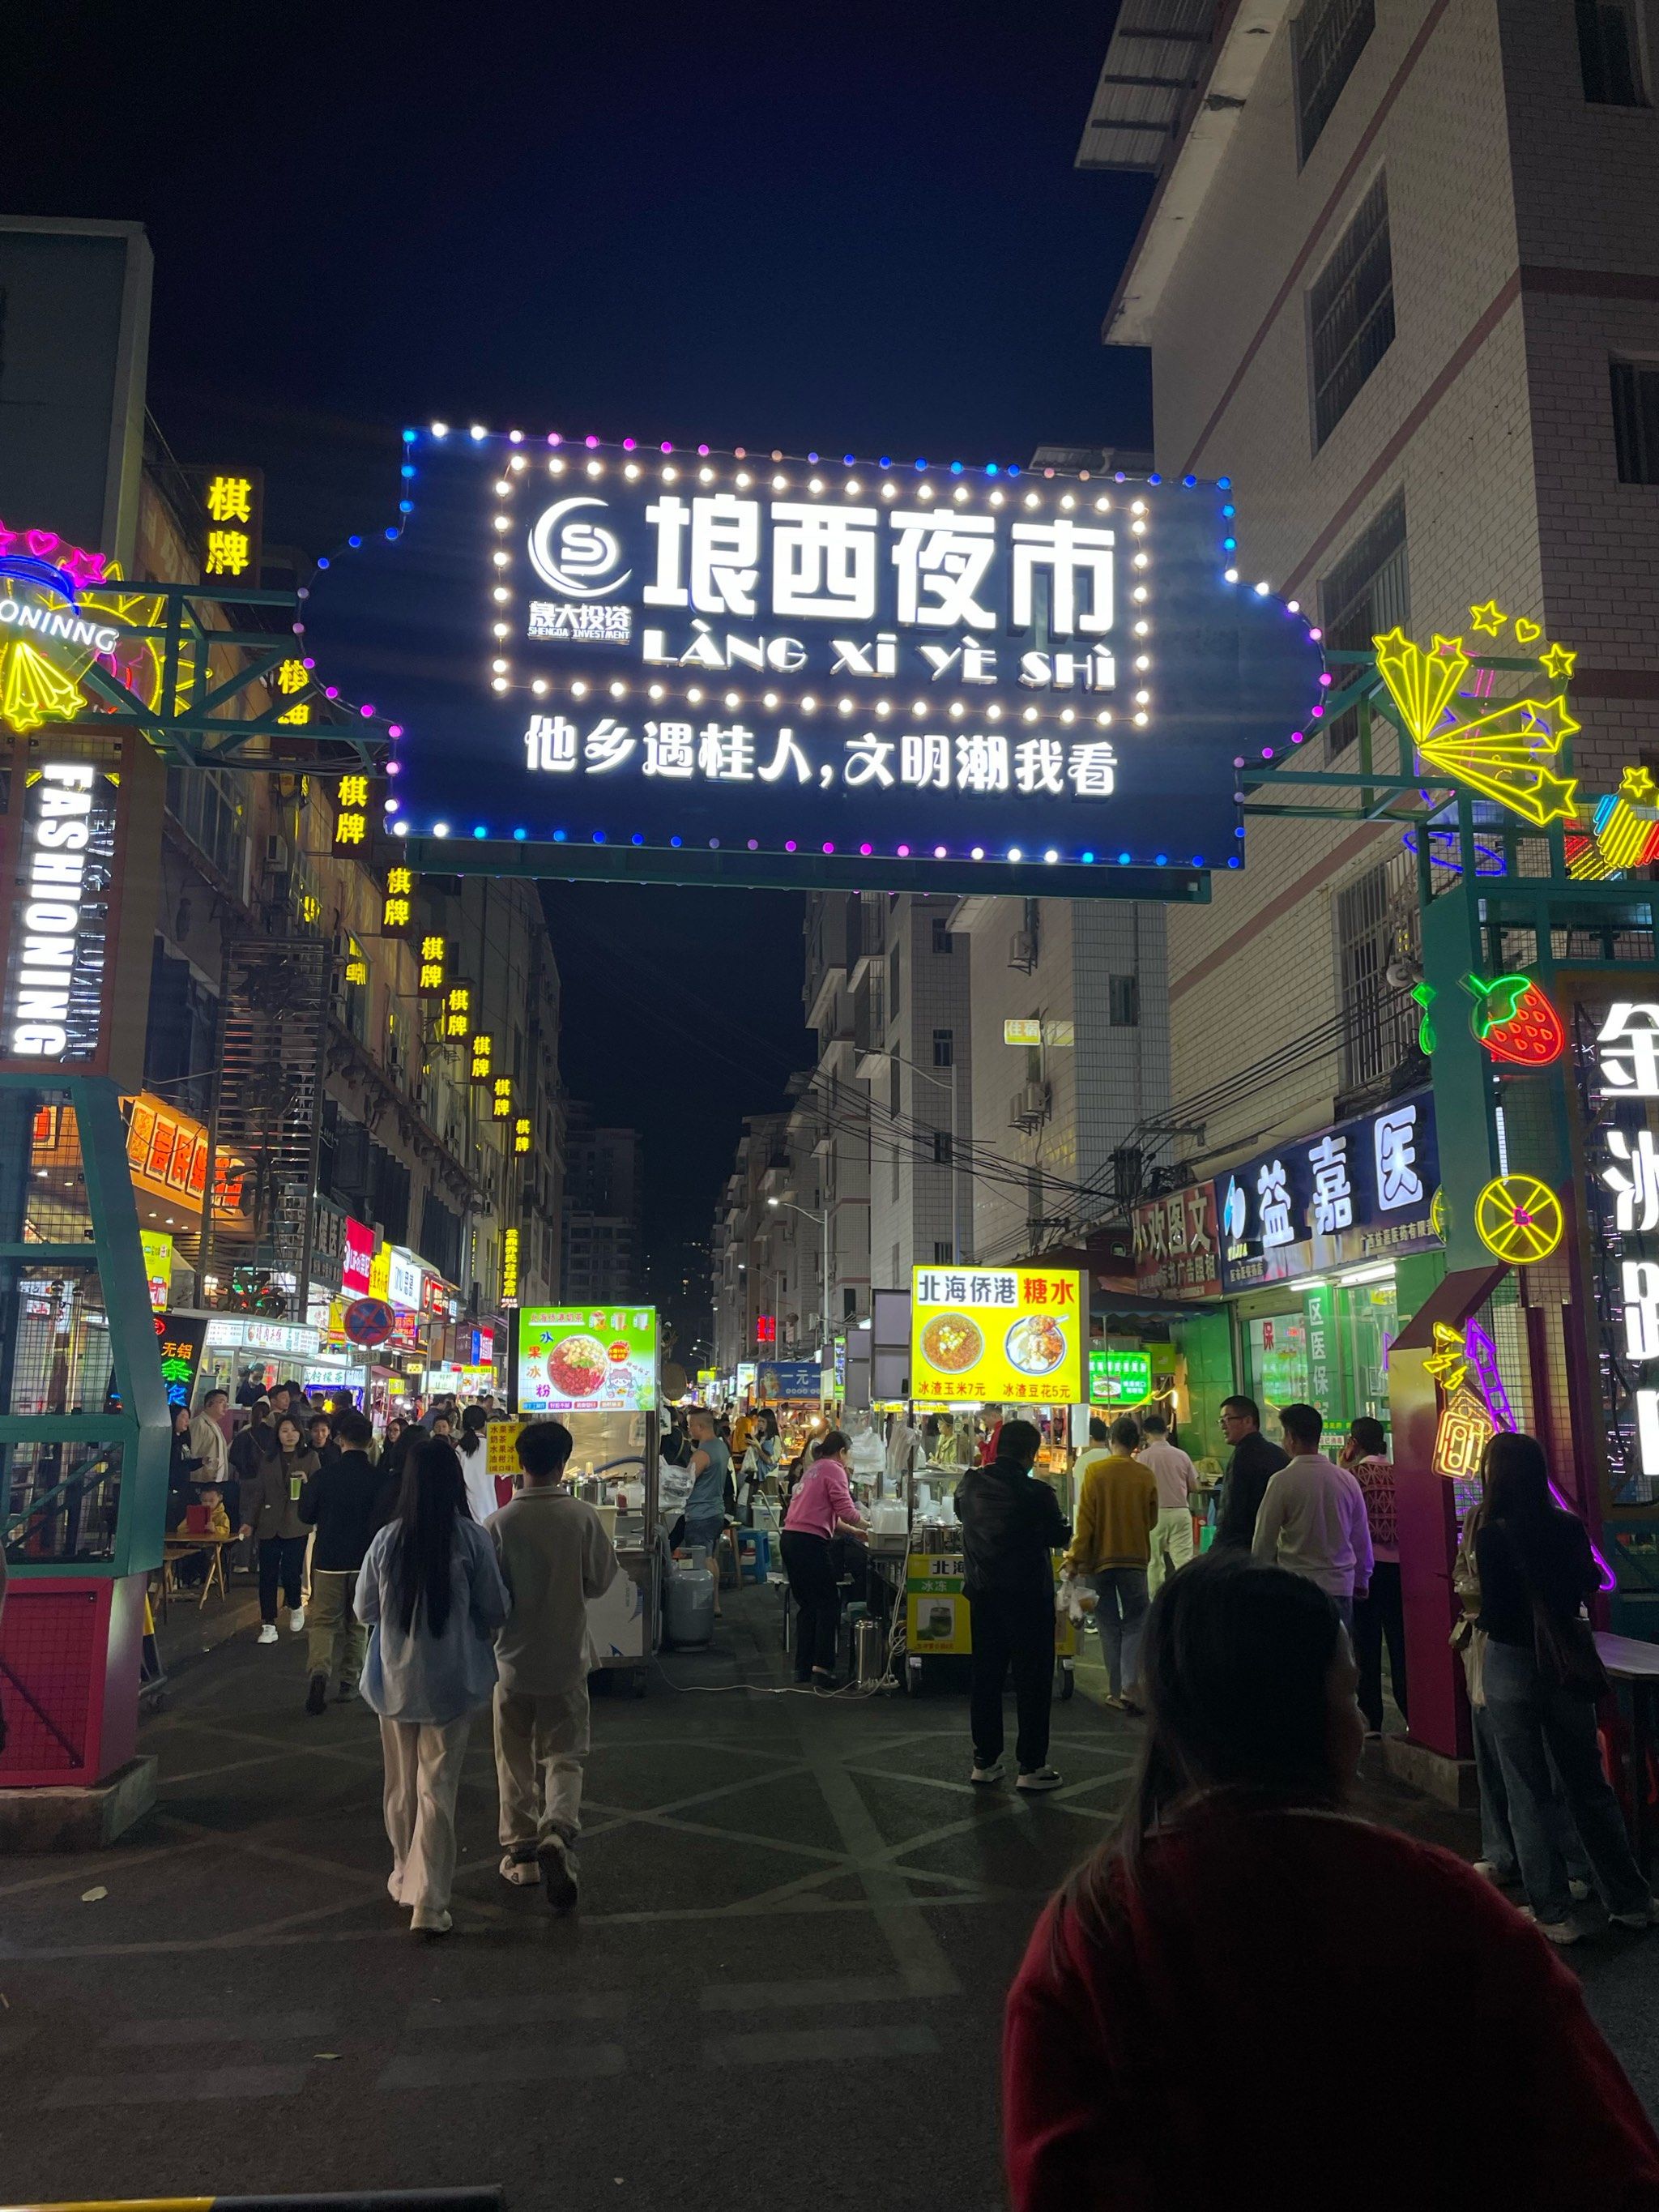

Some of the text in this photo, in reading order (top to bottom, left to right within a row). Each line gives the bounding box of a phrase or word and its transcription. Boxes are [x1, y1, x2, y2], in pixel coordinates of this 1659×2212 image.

[207, 477, 251, 574] 棋牌
[644, 493, 1115, 635] 埌西夜市
[528, 627, 630, 639] SHENGDA INVESTMENT
[529, 601, 631, 631] 晟大投资
[335, 775, 368, 845] 棋牌
[14, 764, 95, 1055] FASHIONING
[384, 868, 412, 926] 棋牌
[420, 936, 444, 989] 棋牌
[447, 989, 469, 1036] 棋牌
[471, 1036, 491, 1078] 棋牌
[494, 1078, 511, 1116] 棋牌
[515, 1119, 531, 1152] 棋牌
[1257, 1104, 1423, 1249] 益嘉医
[1360, 1218, 1436, 1249] 广西益嘉医药有限责
[918, 1275, 1075, 1306] 北海侨港 糖水
[918, 1381, 1071, 1399] 冰渣玉米7元 冰渣豆花5元
[490, 1425, 516, 1433] 水果茶
[490, 1445, 515, 1453] 水果冰
[921, 1580, 947, 1592] 冰冻
